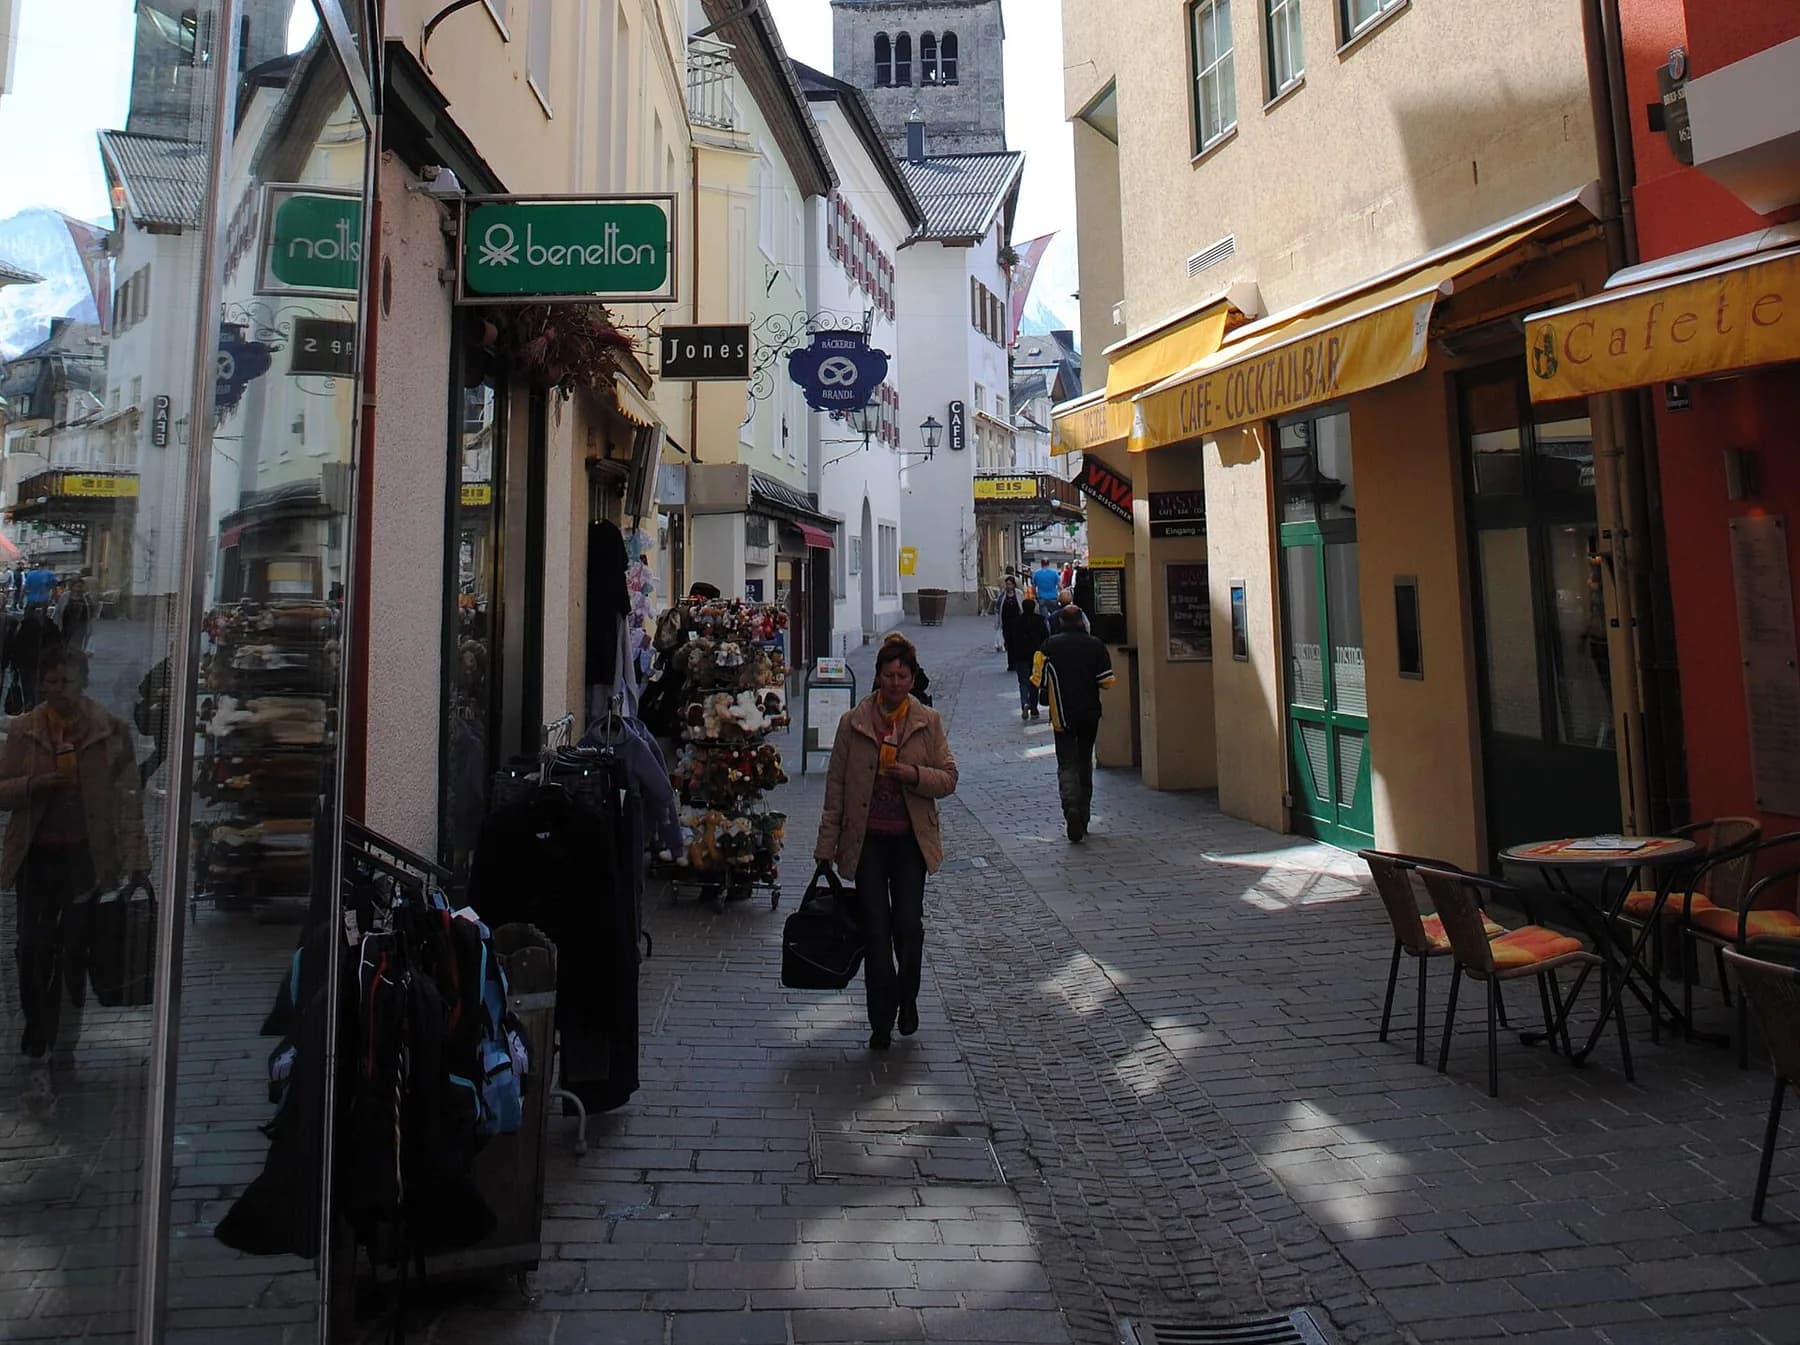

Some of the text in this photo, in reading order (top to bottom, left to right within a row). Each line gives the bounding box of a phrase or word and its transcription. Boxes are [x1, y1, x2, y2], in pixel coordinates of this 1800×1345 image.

[526, 222, 655, 265] benetton
[1563, 292, 1784, 364] Cafete
[666, 339, 744, 364] Jones
[823, 389, 854, 400] BRANDL
[1181, 381, 1212, 433] CAFE
[1225, 337, 1339, 420] COCKTAILBAR
[951, 402, 961, 448] CAFE
[996, 482, 1022, 491] EIS
[1087, 464, 1134, 514] VIVA
